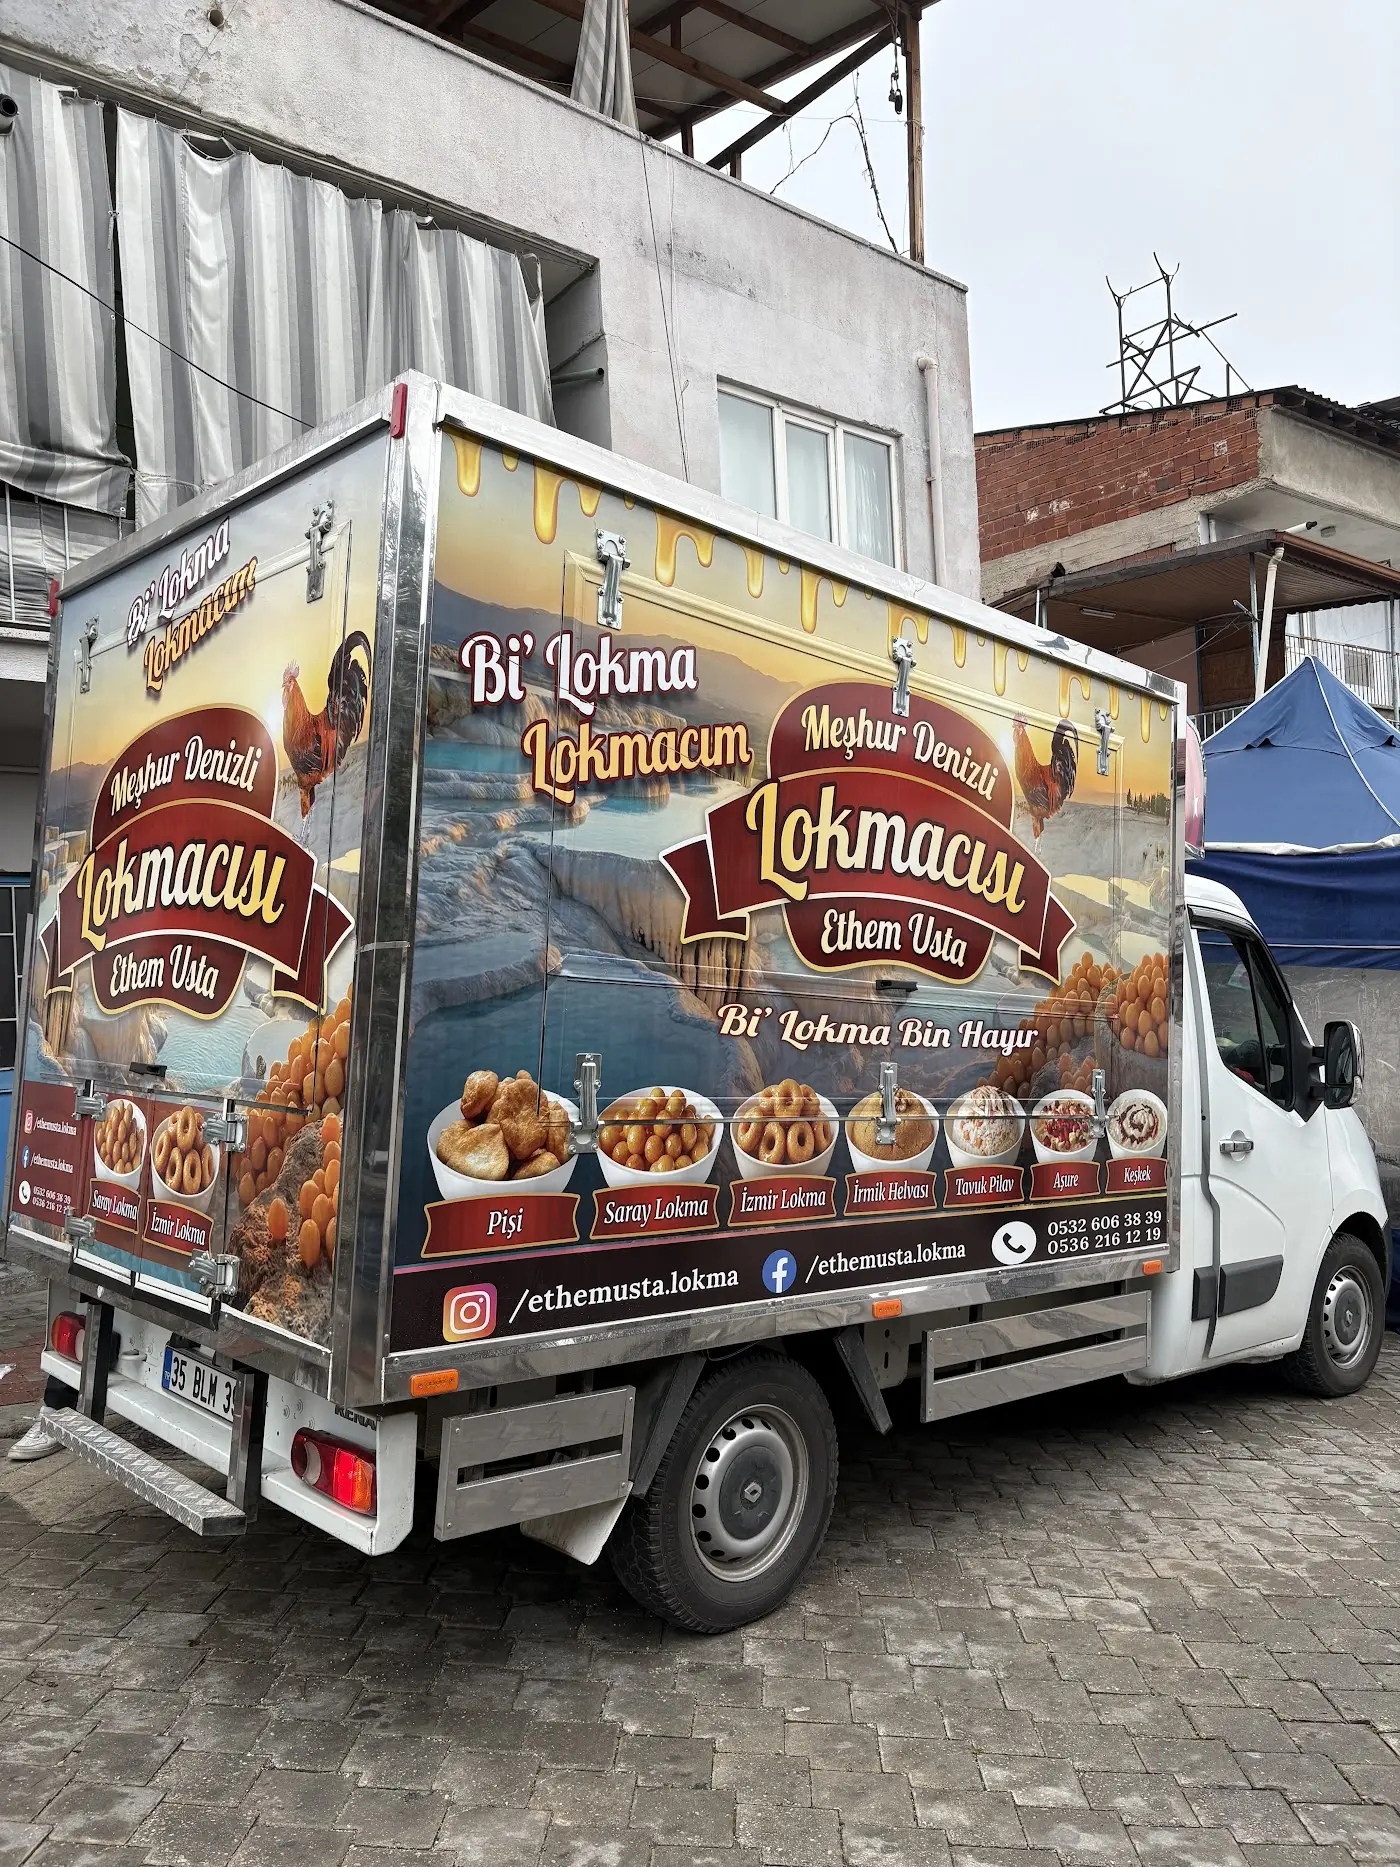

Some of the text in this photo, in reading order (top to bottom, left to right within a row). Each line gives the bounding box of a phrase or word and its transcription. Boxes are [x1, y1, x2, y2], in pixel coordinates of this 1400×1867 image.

[157, 517, 231, 619] Lokma
[144, 556, 258, 692] Lokmacım
[545, 631, 698, 716] Lokma
[523, 719, 752, 804] Lokmacım
[801, 704, 999, 801] Meşhur Denizli
[111, 735, 262, 817] Meşhur Denizli
[745, 781, 1026, 914] Lokmacısı
[77, 838, 287, 952] Lokmacısı
[820, 908, 968, 967] Ethem Usta
[110, 944, 219, 1000] Ethem Usta
[778, 1008, 890, 1051] Lokma
[898, 1017, 951, 1048] Bin
[958, 1019, 1039, 1055] Hayır
[853, 1179, 929, 1203] İrmik Helvası
[955, 1174, 1014, 1196] Tavuk Pilav
[1053, 1171, 1079, 1192] Aşure
[1123, 1165, 1151, 1186] Keşkek
[93, 1189, 137, 1220] Saray Lokma
[604, 1195, 709, 1228] Saray Lokma
[740, 1186, 827, 1213] İzmir Lokma
[150, 1207, 206, 1246] İzmir Lokma
[487, 1207, 523, 1239] Pişi
[1047, 1210, 1162, 1237] 0532 606 38 39
[1047, 1227, 1161, 1255] 0536 216 12 19
[805, 1241, 966, 1284] /ethemusta.lokma
[508, 1266, 739, 1324] /ethemusta.lokma
[171, 1356, 188, 1391] 35
[192, 1366, 218, 1408] BLM
[335, 1404, 377, 1432] RENA
